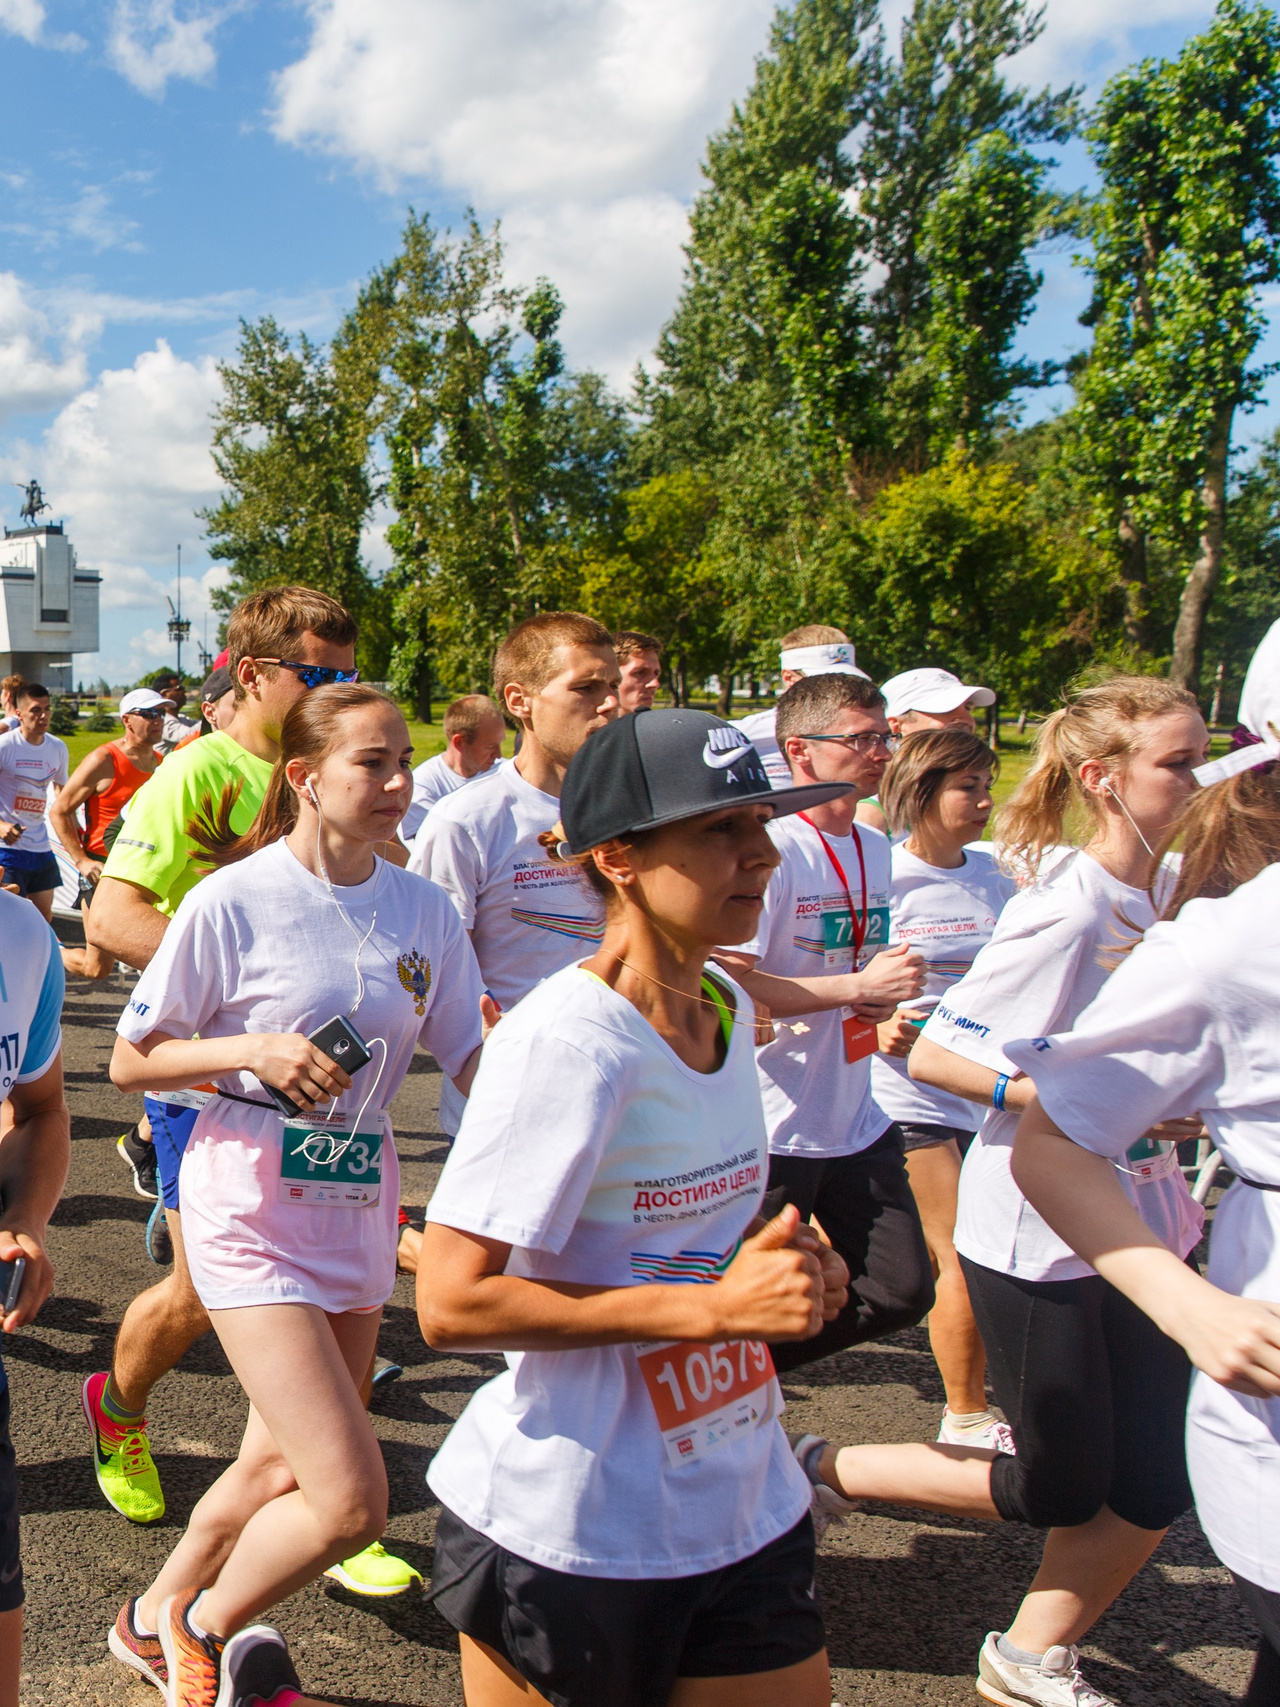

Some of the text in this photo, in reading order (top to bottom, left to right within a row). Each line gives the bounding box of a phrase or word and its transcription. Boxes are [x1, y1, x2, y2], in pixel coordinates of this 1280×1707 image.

[898, 923, 978, 939] ДОСТИГАЯ ЦЕЛИ!
[937, 1005, 991, 1038] РУТ-МИИТ
[296, 1113, 328, 1122] ОСТИГАЯ
[307, 1139, 383, 1176] 7734
[633, 1177, 728, 1211] ДОСТИГАЯ
[656, 1339, 767, 1412] 10579
